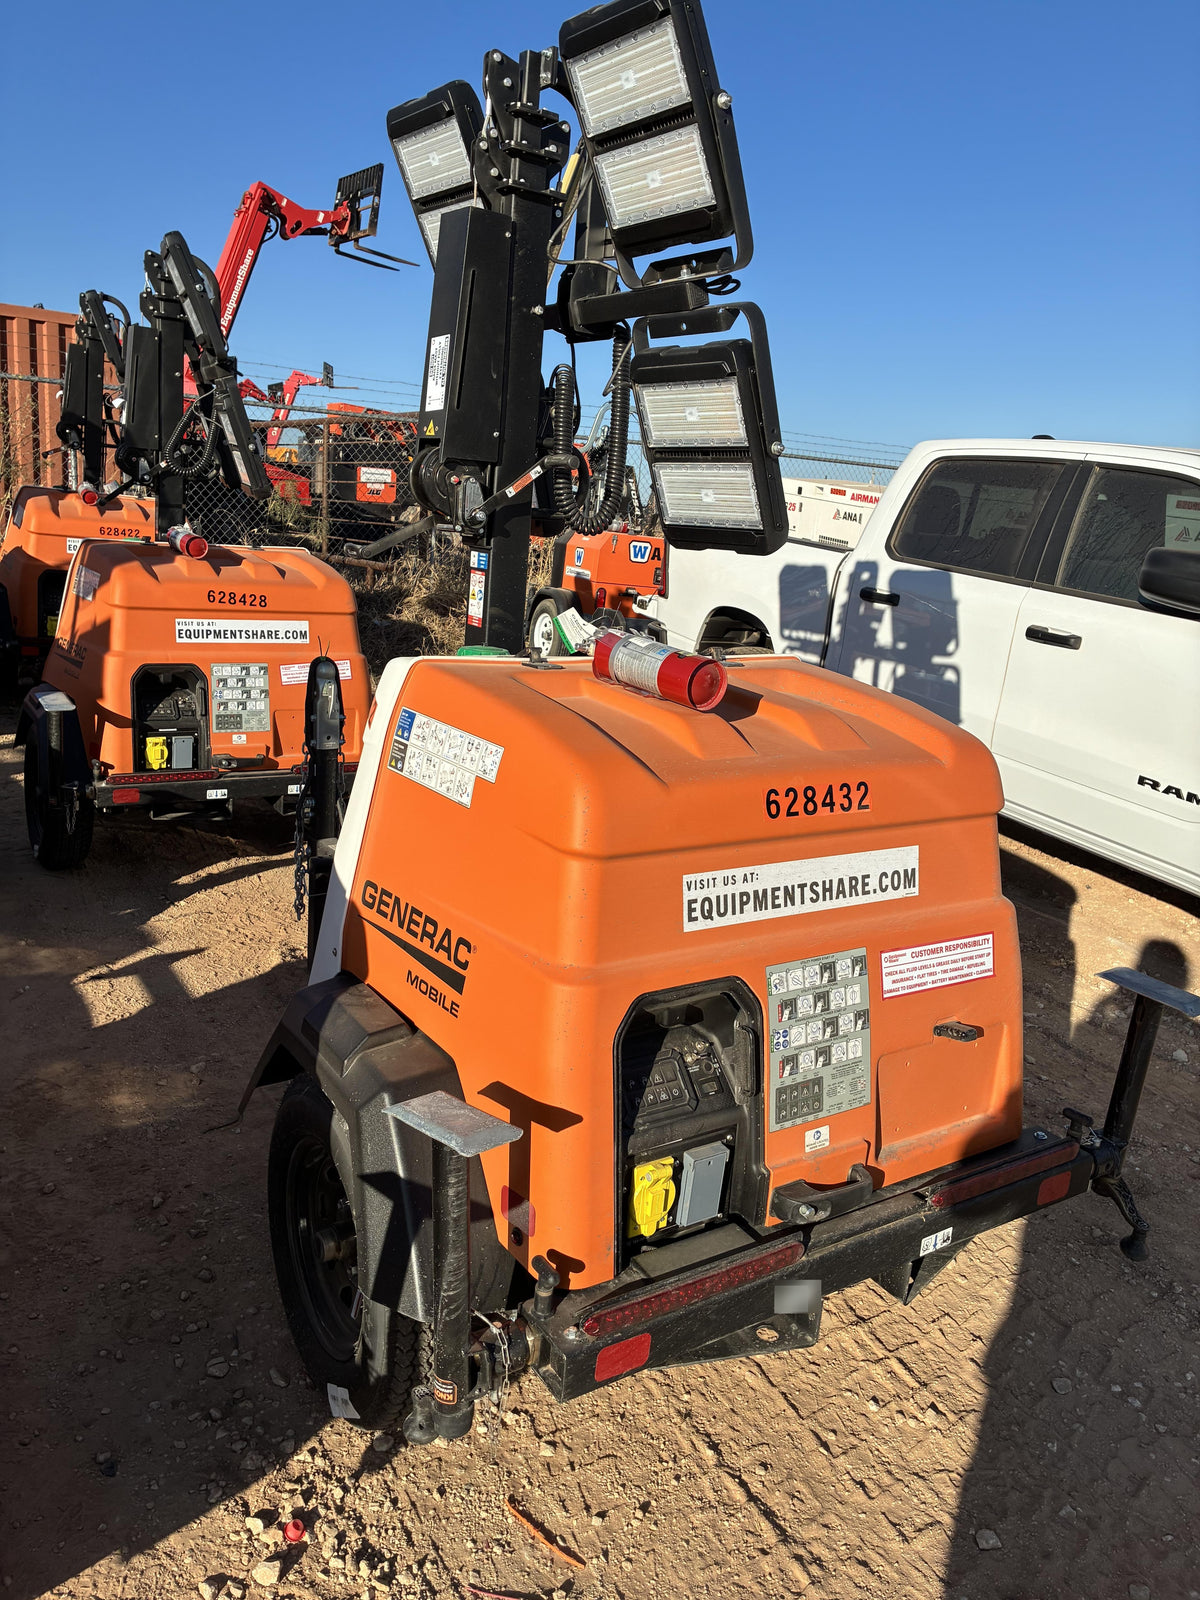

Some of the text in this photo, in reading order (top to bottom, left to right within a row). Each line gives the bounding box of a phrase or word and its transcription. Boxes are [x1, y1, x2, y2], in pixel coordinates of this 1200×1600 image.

[220, 248, 254, 327] EquipmentShare
[850, 493, 880, 504] AIRMAN
[842, 512, 857, 522] ANA
[99, 526, 140, 538] 628422
[207, 590, 268, 608] 628428
[177, 628, 308, 640] EQUIPMENTSHARE.COM
[765, 781, 871, 819] 628432
[686, 872, 760, 892] VISIT US AT:
[686, 867, 917, 922] EQUIPMENTSHARE.COM
[361, 879, 472, 971] GENERAC
[911, 938, 991, 959] CUSTOMER RESPONSIBILITY
[918, 963, 932, 971] LEVELS
[931, 977, 948, 985] BATTERY
[406, 969, 460, 1019] MOBILE
